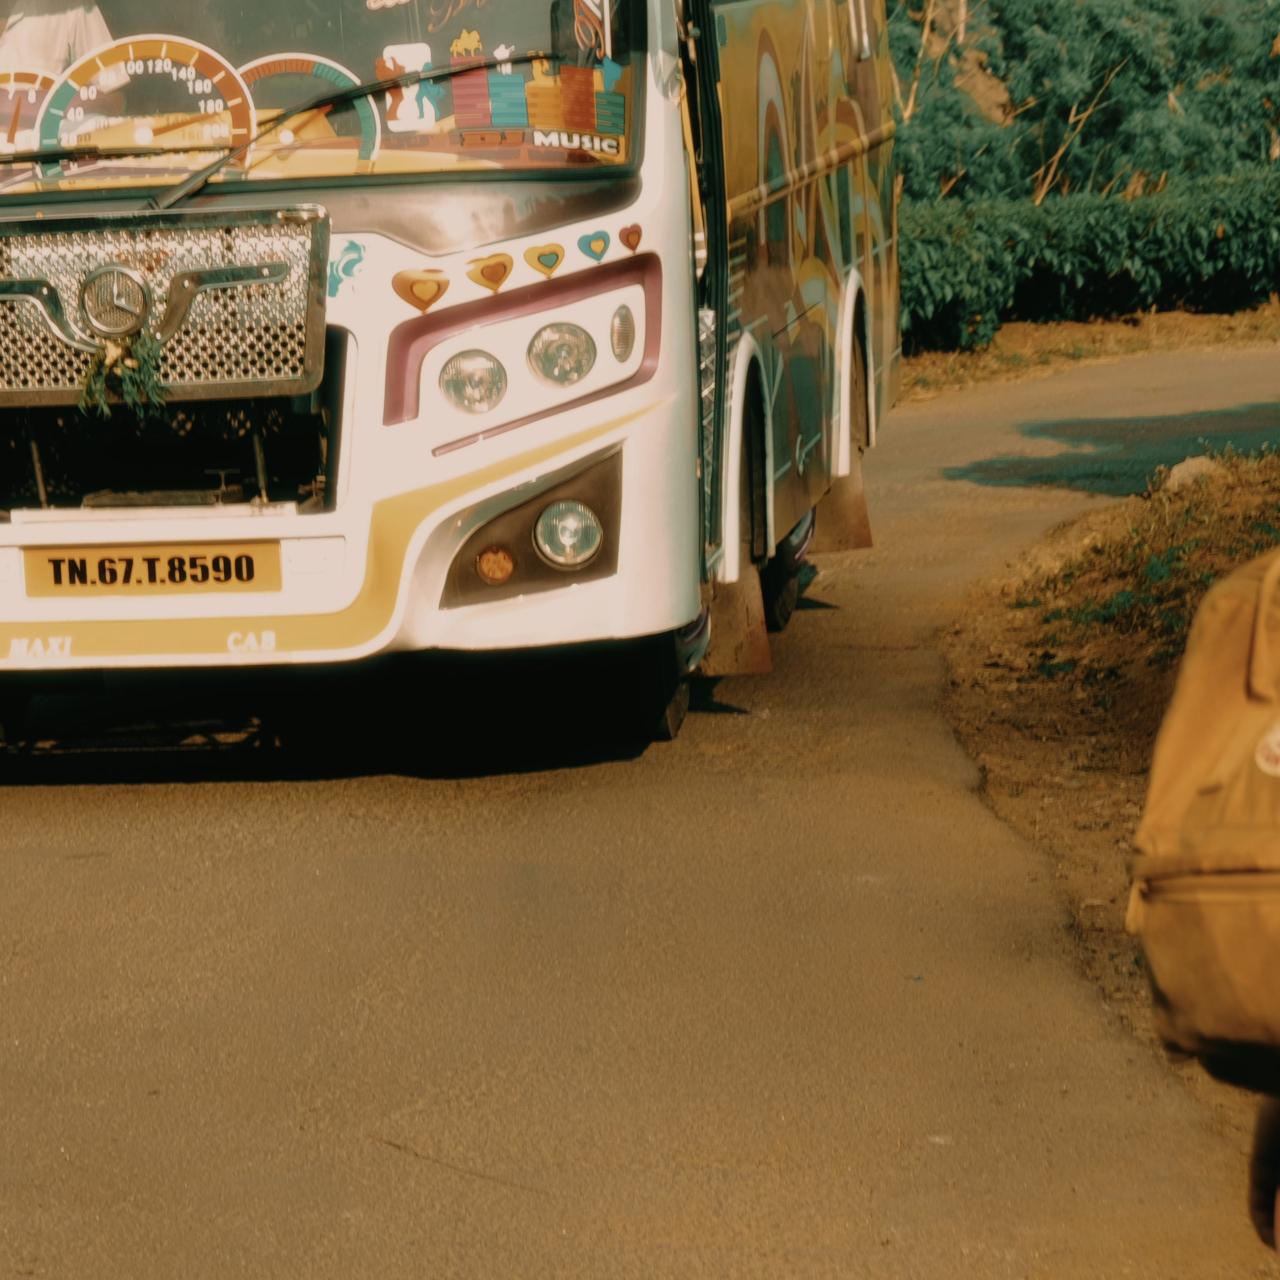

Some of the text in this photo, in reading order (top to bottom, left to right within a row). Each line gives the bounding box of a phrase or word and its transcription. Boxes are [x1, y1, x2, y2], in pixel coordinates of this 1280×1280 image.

[147, 58, 172, 74] 120
[66, 107, 84, 121] 40
[533, 130, 619, 154] MUSIC
[48, 554, 255, 585] TN.67.T.8590
[9, 631, 276, 657] MAXI CAB
